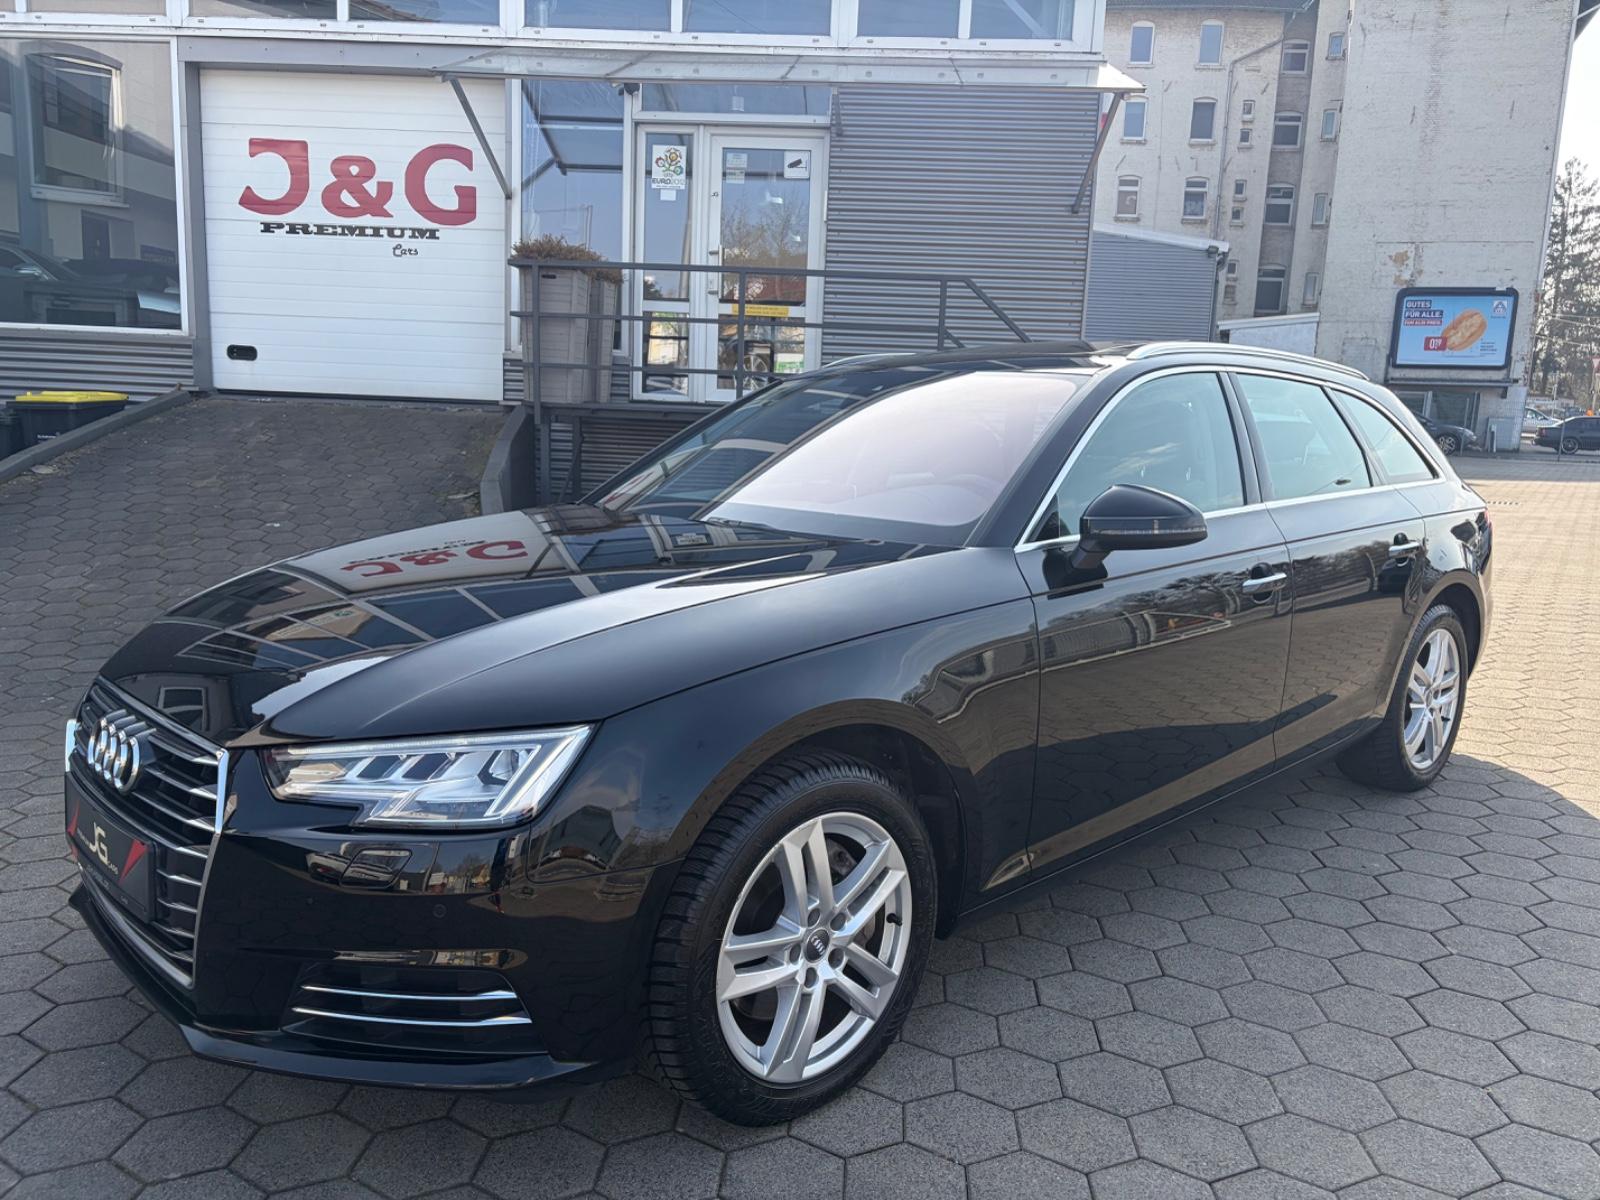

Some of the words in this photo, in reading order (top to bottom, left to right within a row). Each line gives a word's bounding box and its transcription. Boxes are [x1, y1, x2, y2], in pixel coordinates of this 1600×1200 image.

[238, 138, 477, 226] J&G
[260, 222, 440, 240] PREMIUM
[392, 243, 419, 257] Cars
[1406, 300, 1431, 308] GUTES
[1405, 309, 1420, 318] FÜR
